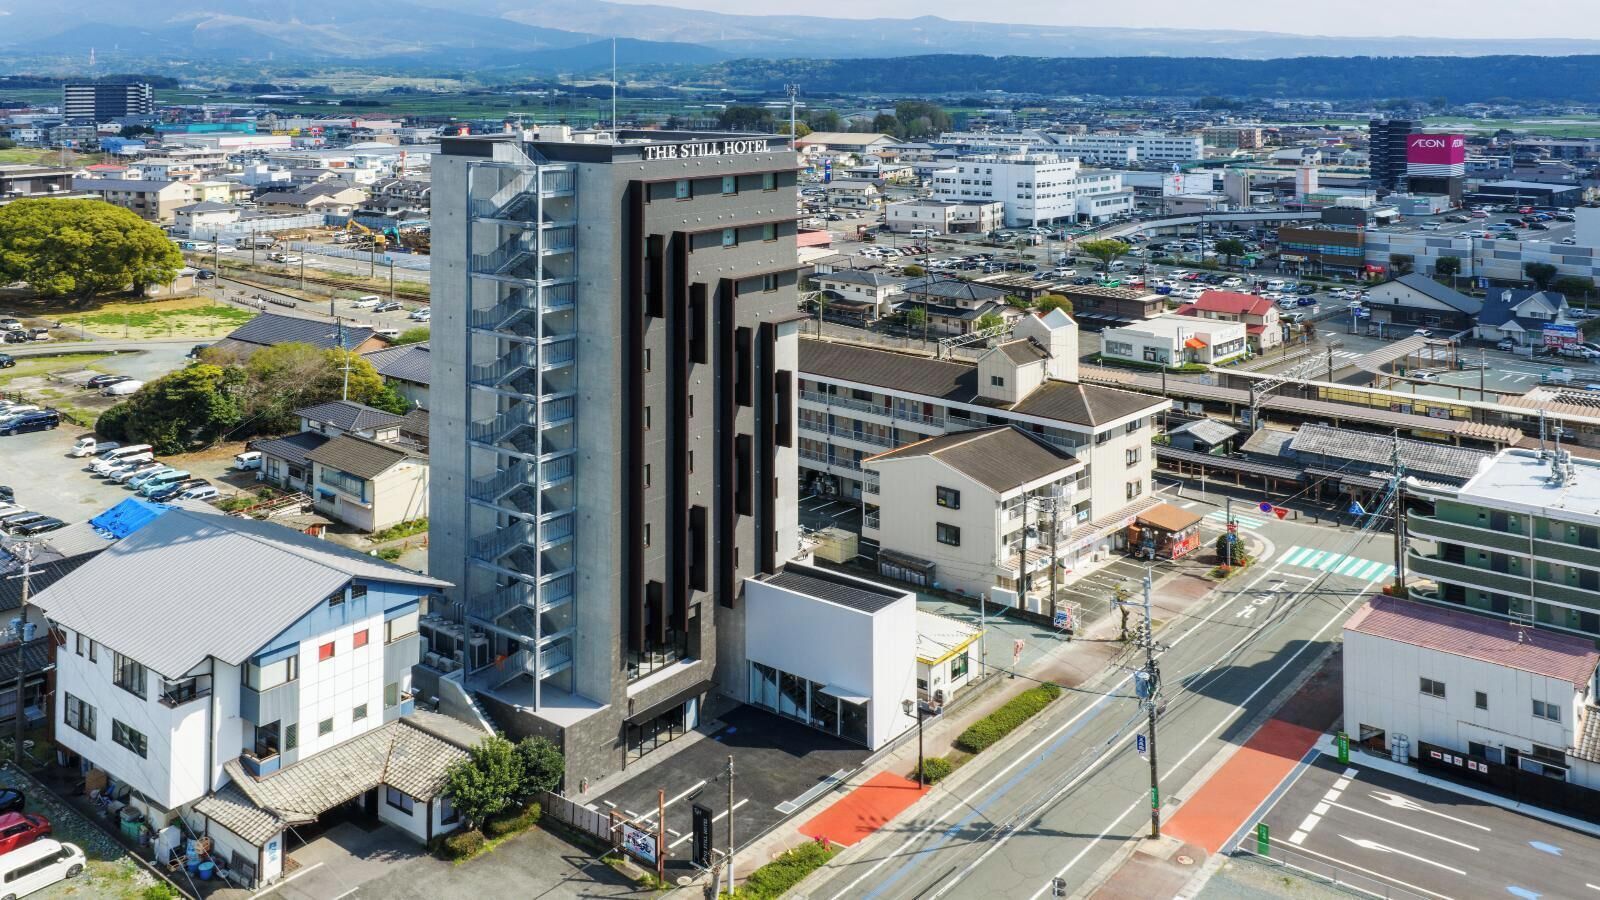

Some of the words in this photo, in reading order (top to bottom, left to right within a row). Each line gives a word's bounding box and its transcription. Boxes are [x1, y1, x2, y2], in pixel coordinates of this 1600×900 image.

[645, 145, 677, 160] THE
[681, 142, 720, 158] STILL
[724, 140, 770, 155] HOTEL
